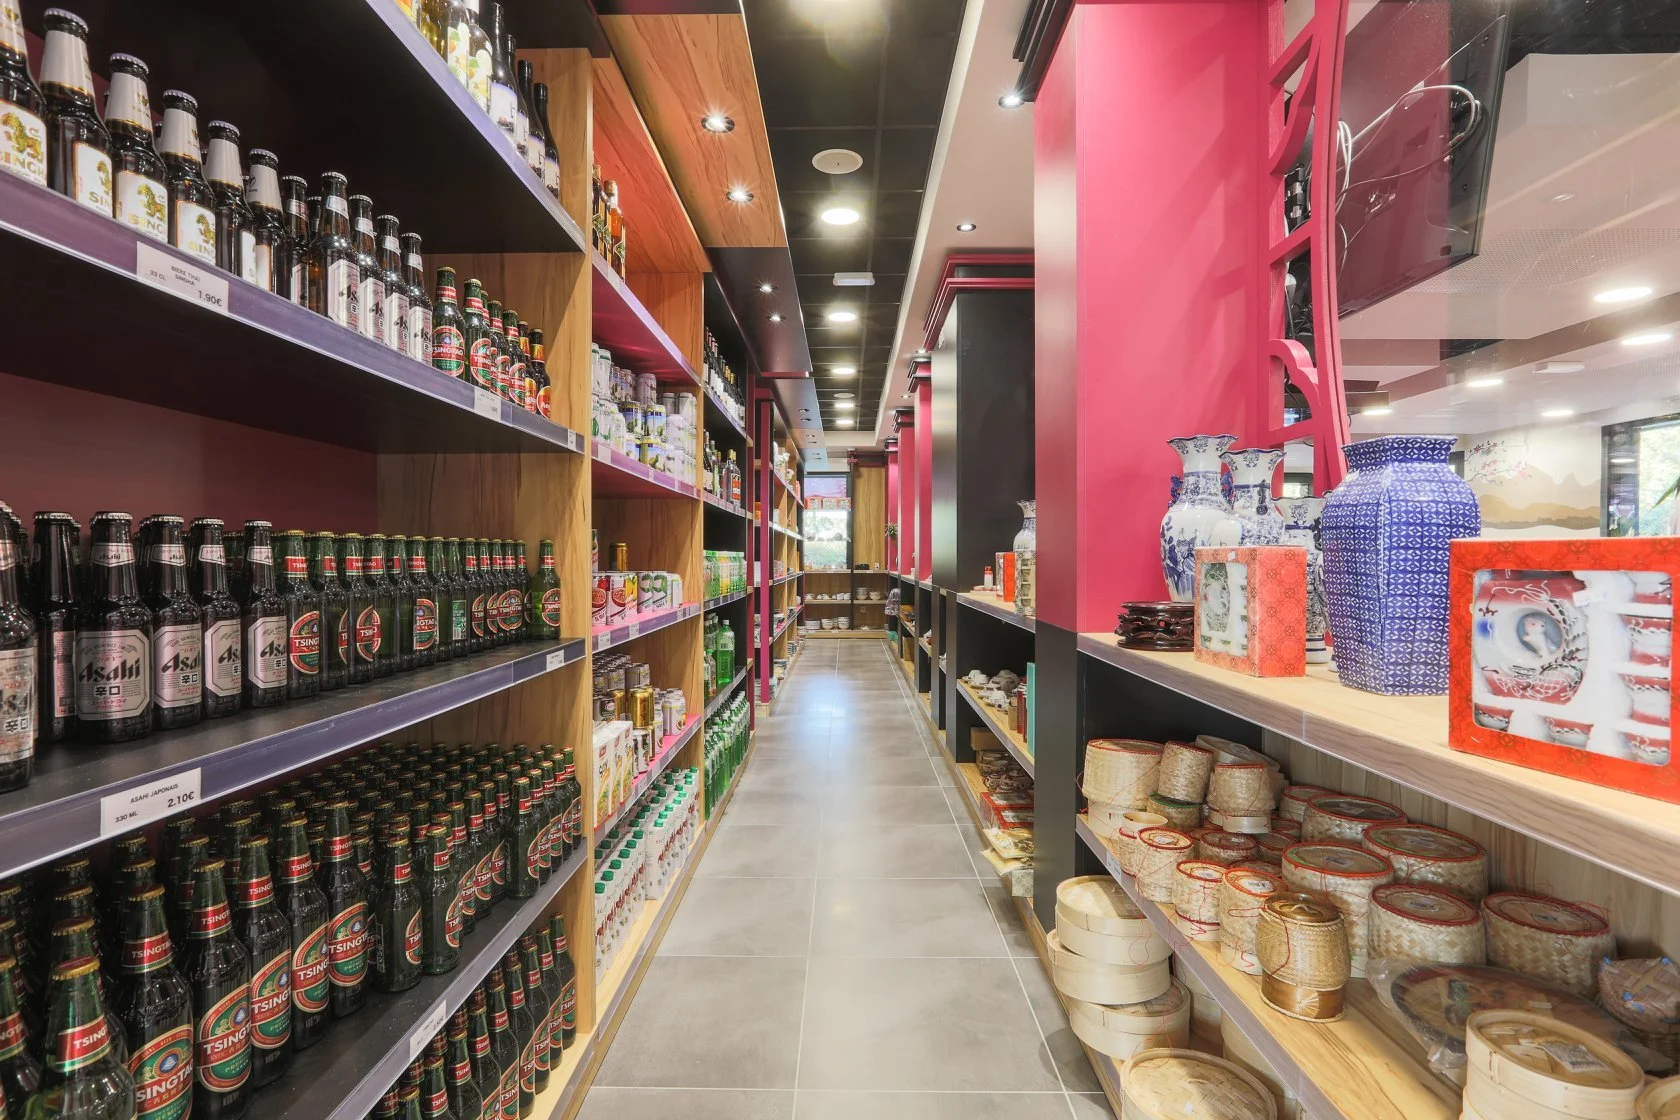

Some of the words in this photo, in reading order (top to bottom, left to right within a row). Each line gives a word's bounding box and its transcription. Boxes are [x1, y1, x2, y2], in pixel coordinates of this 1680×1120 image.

[198, 290, 222, 307] 1.90€
[79, 656, 141, 682] Asahi
[95, 685, 120, 696] 辛口
[130, 793, 149, 803] ASAHI
[150, 783, 178, 797] JAPONAIS
[167, 791, 194, 808] 2.10€
[115, 813, 128, 823] 330
